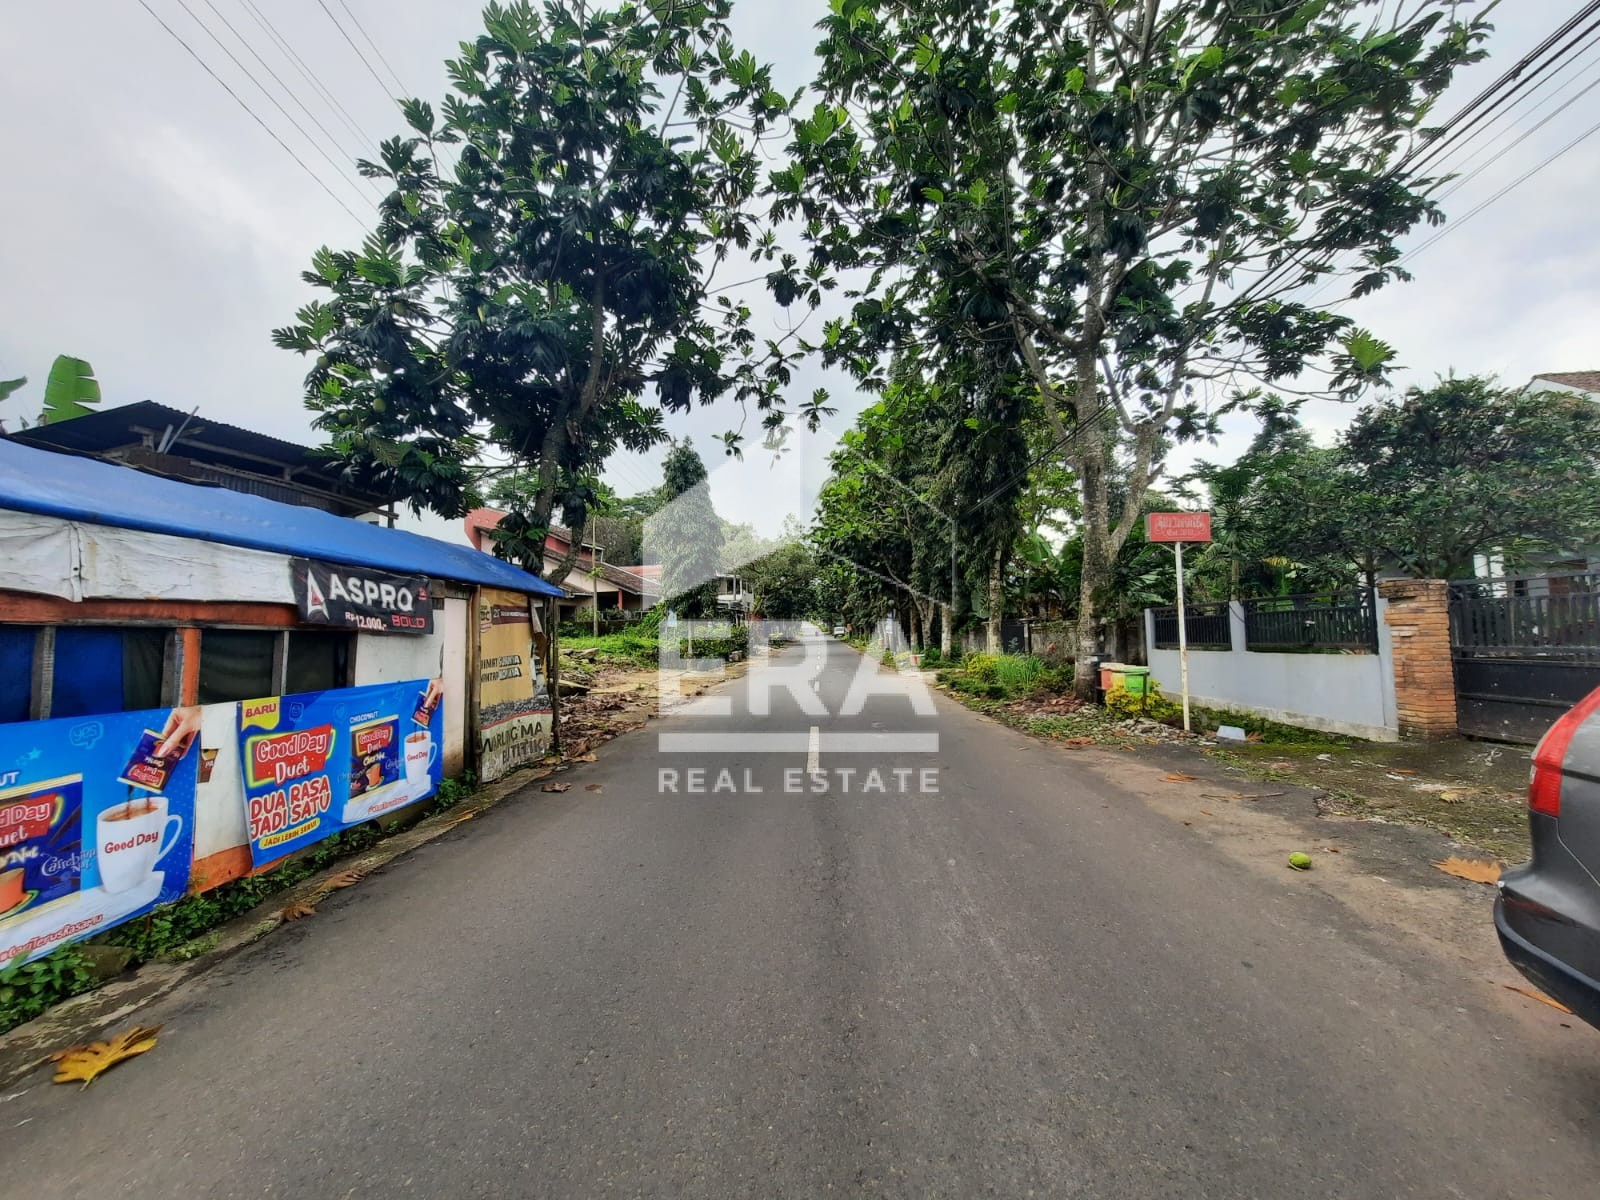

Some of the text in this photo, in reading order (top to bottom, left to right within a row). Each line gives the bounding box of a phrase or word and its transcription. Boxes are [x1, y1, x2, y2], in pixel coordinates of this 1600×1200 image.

[392, 613, 425, 629] BOLD
[245, 703, 277, 718] BARU
[256, 732, 327, 763] Good Day
[275, 759, 310, 785] Duet
[250, 789, 288, 820] DUA
[289, 775, 330, 807] RASA
[10, 802, 50, 825] Day
[250, 809, 288, 841] JADI
[289, 792, 331, 825] SATU
[105, 830, 159, 854] Good Day
[263, 836, 281, 847] JADI
[281, 830, 299, 842] LEBIH
